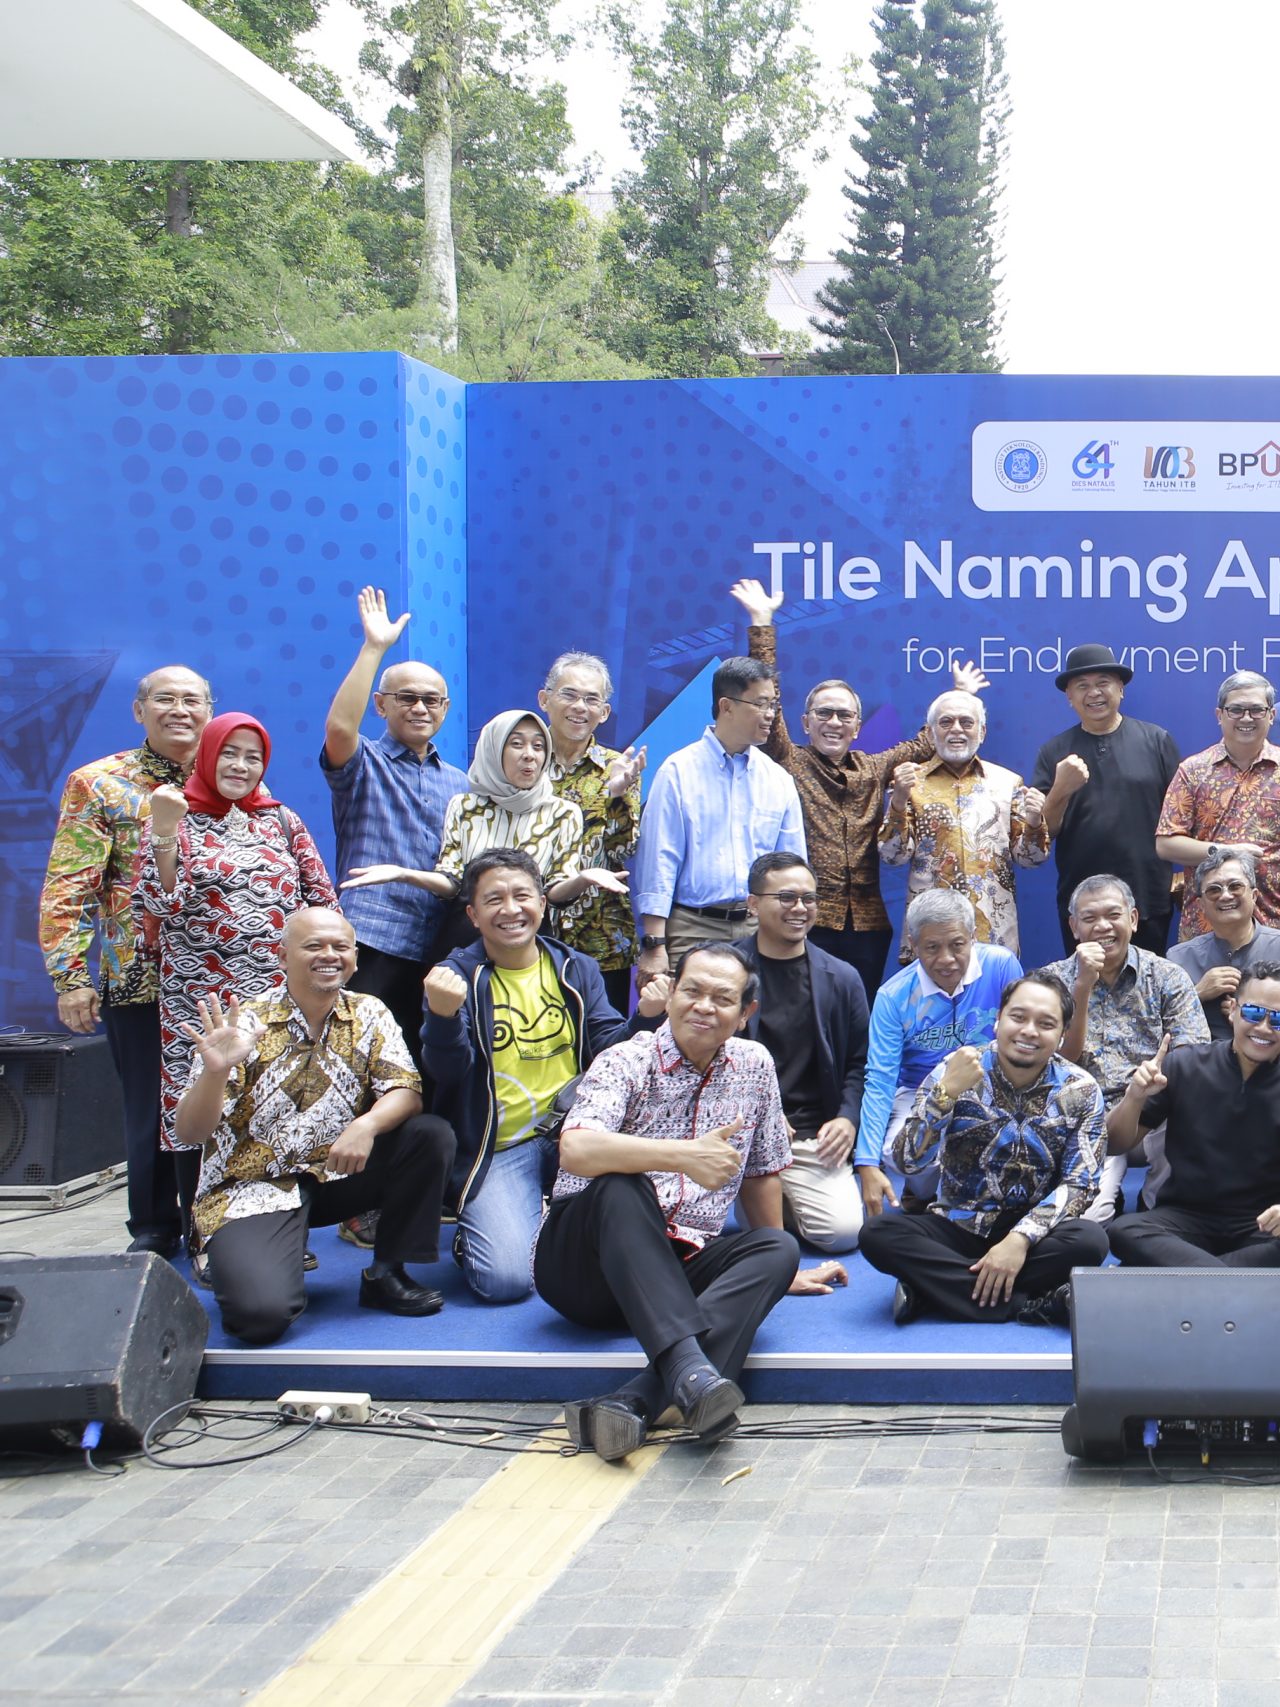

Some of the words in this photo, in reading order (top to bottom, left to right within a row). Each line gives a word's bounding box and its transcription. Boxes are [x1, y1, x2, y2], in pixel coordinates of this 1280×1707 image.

[753, 541, 881, 600] Tile
[903, 539, 1188, 623] Naming
[902, 637, 964, 673] for
[981, 637, 1245, 674] Endment
